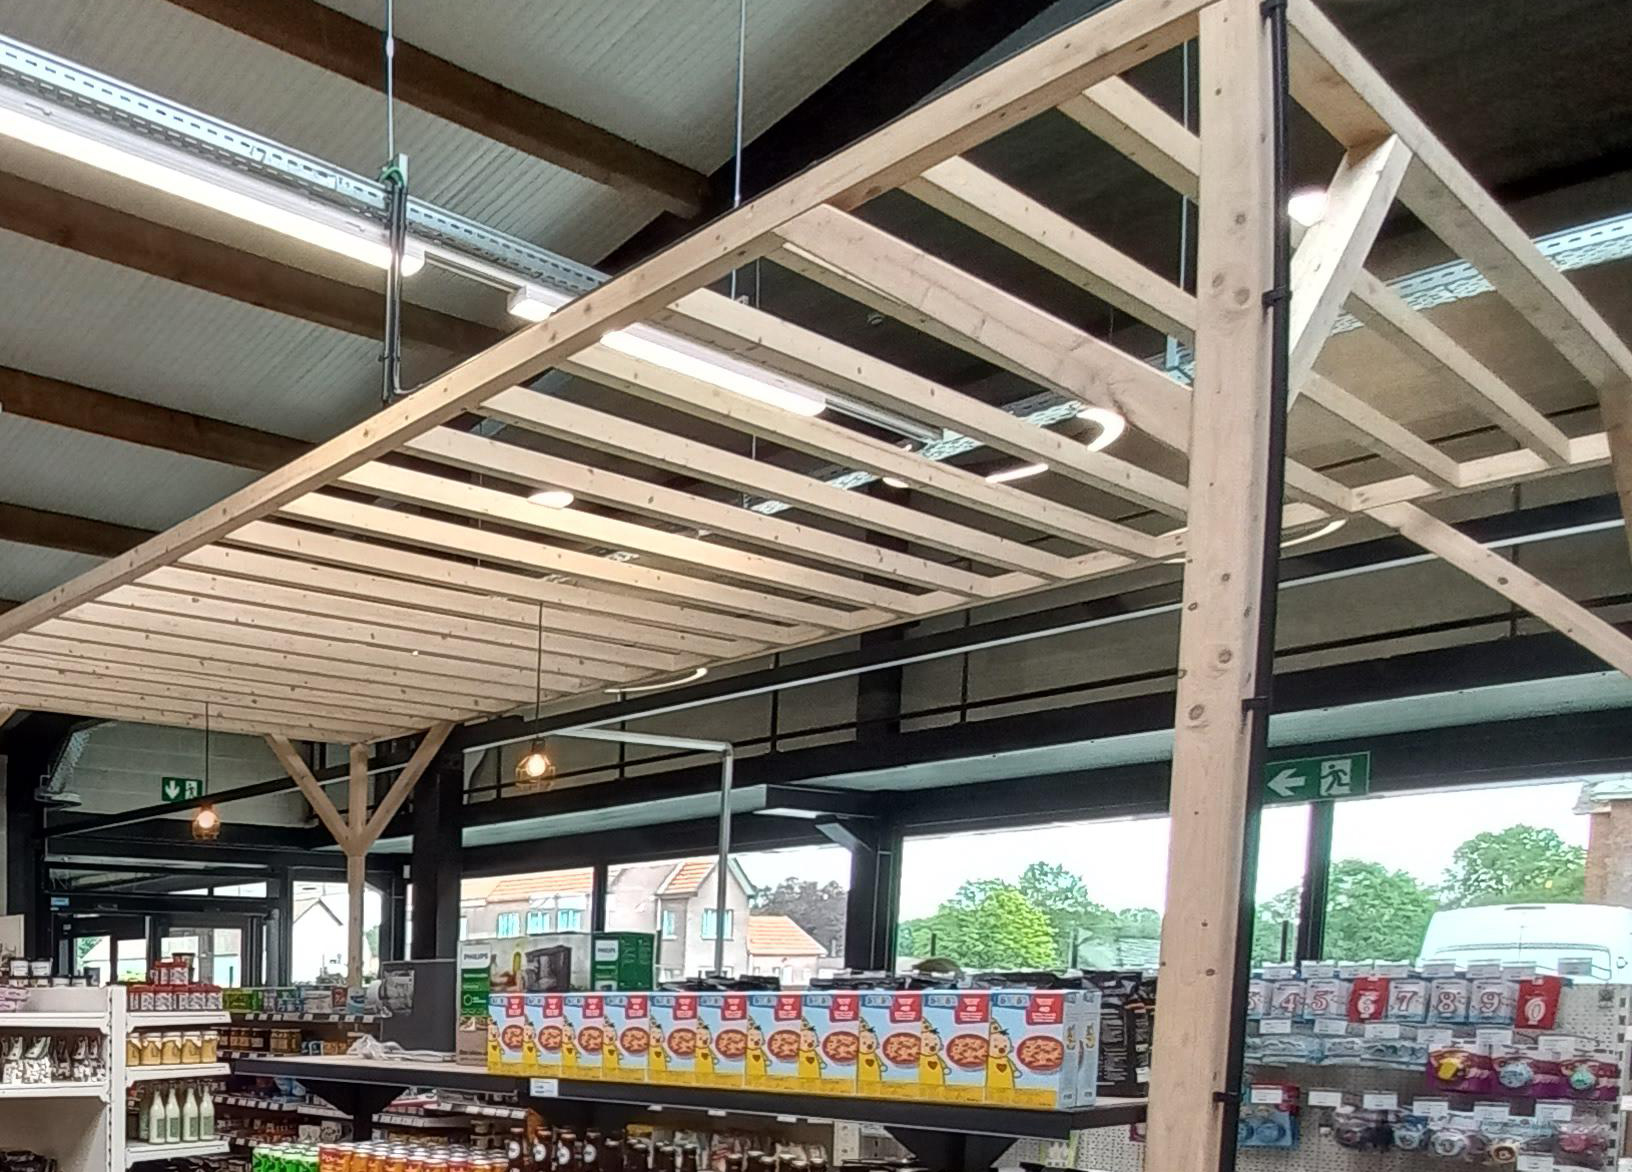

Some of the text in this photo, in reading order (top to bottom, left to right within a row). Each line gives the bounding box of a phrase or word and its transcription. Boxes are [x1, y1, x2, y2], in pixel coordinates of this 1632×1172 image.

[1279, 991, 1299, 1013] 4
[1311, 989, 1333, 1012] 5
[1396, 990, 1418, 1013] 7
[1436, 990, 1457, 1014] 8
[1480, 991, 1502, 1014] 9
